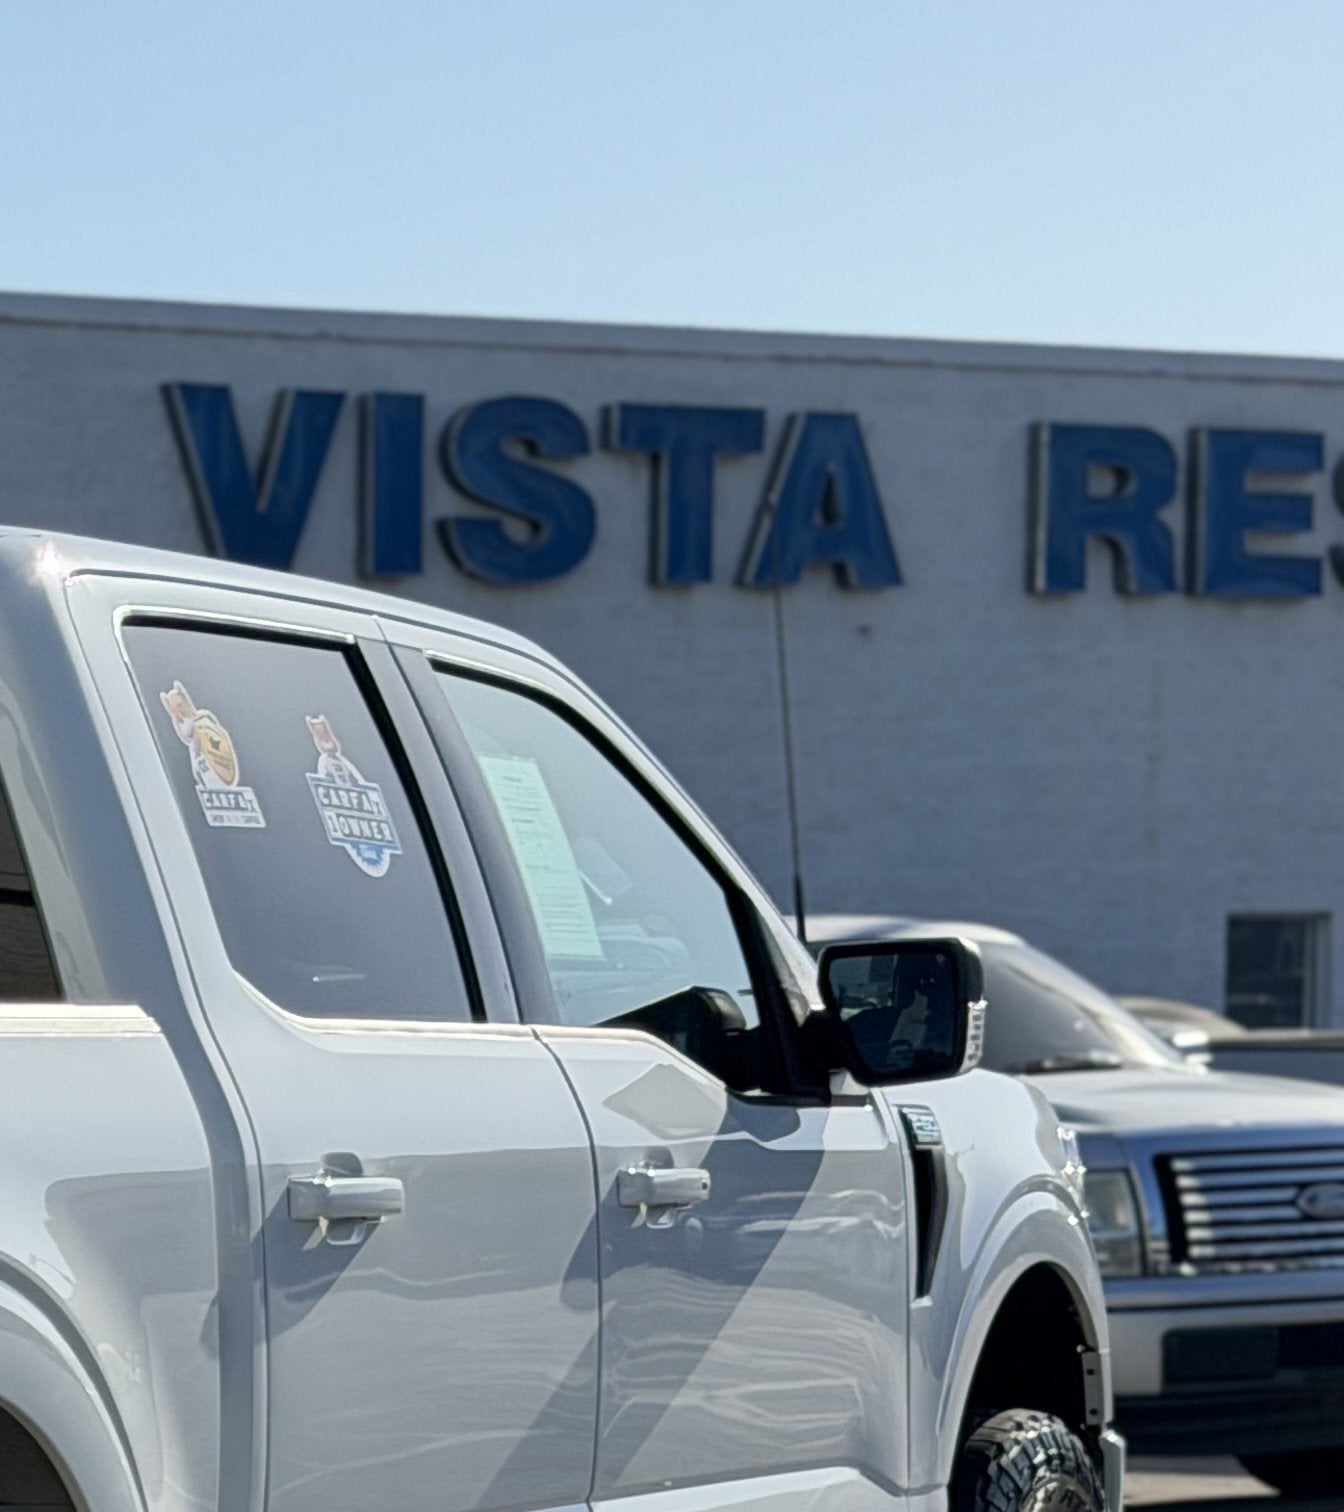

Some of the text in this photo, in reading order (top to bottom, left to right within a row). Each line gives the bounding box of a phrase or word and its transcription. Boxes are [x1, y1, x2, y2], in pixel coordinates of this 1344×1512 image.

[160, 381, 1344, 602] VISTA RE
[316, 785, 386, 816] CARFAX
